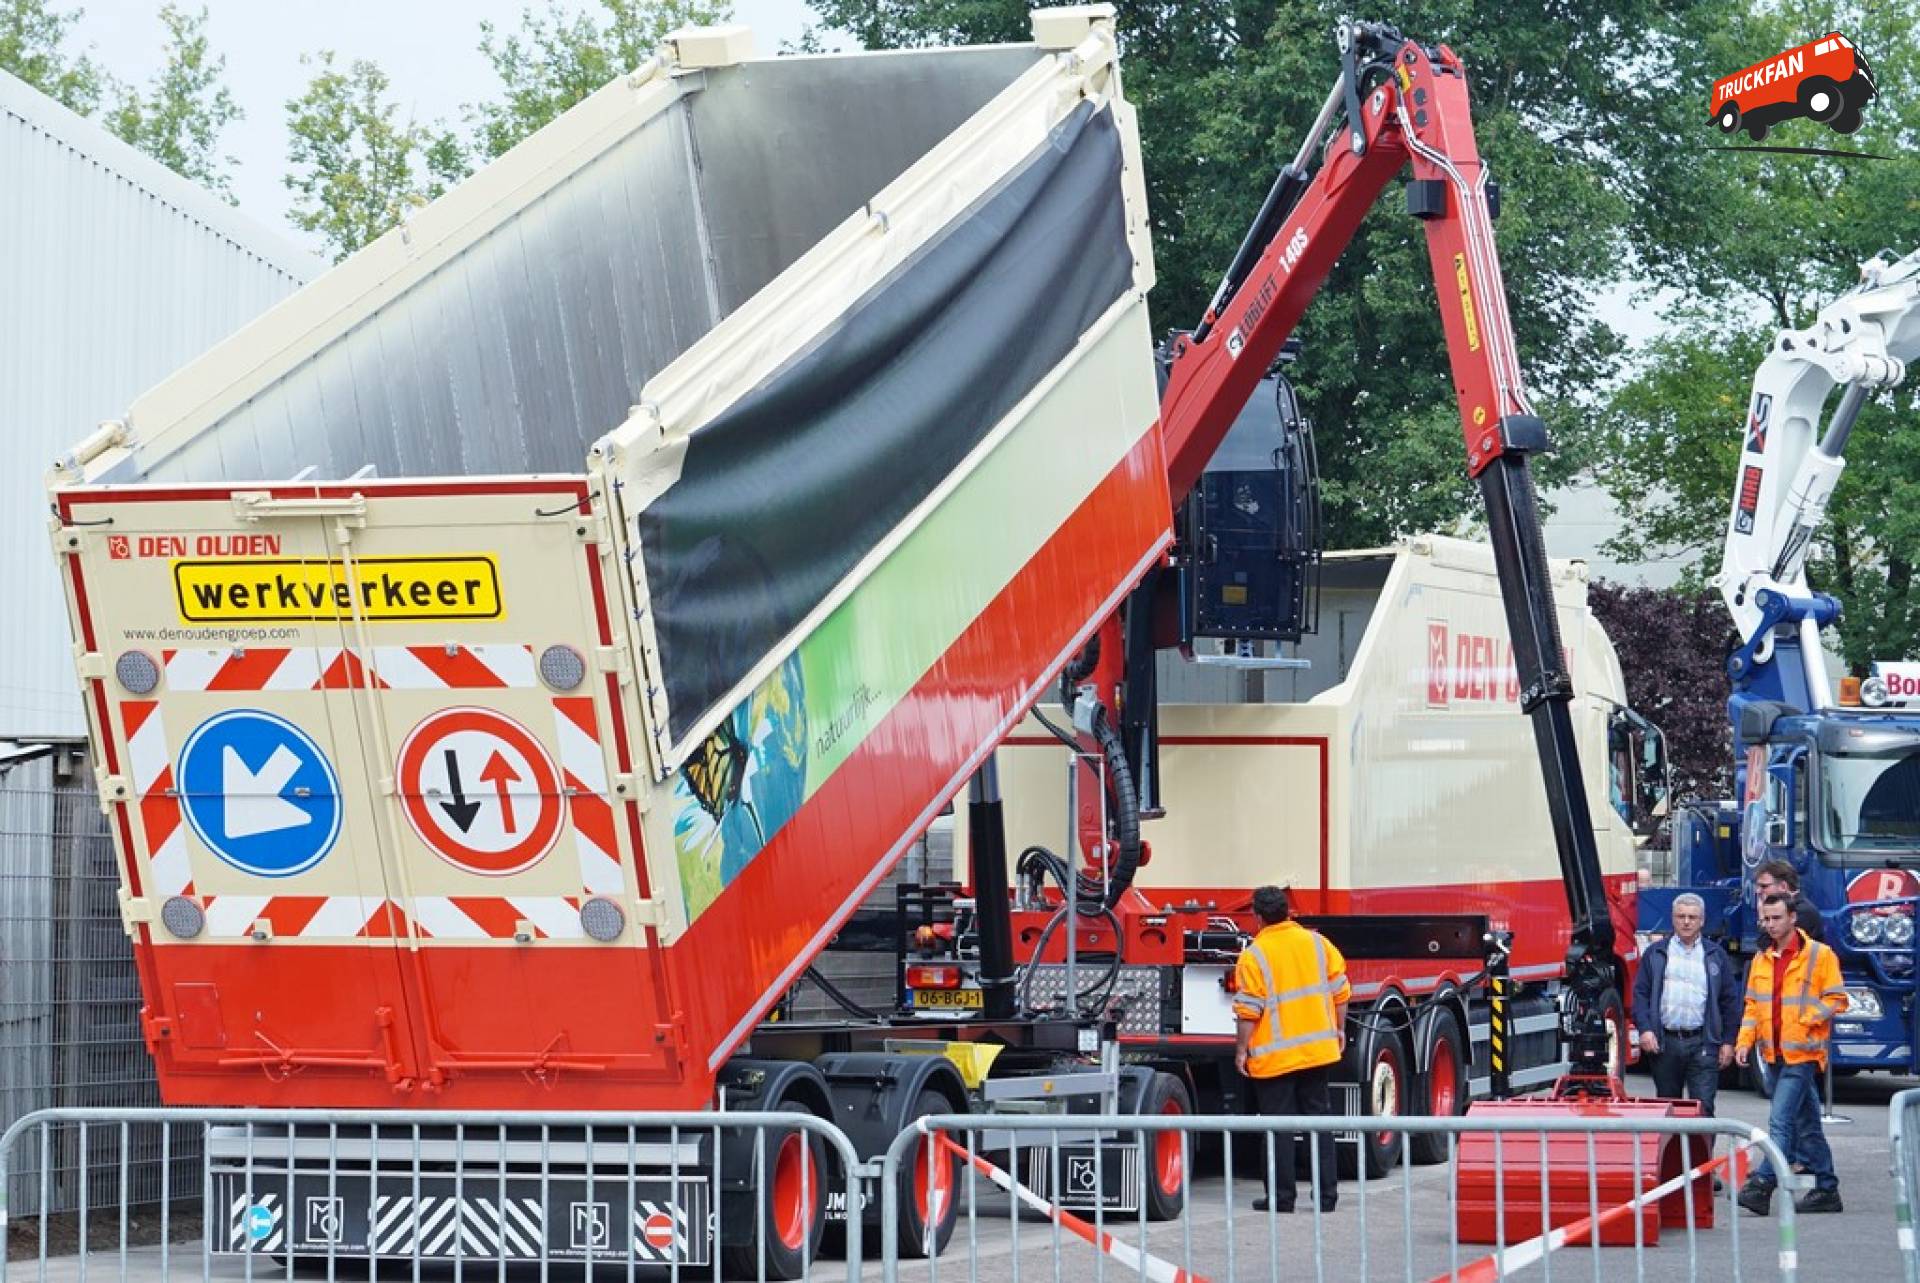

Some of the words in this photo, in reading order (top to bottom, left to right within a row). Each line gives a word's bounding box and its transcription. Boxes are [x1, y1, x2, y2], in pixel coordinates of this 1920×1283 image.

[1279, 226, 1309, 274] 140S
[138, 535, 187, 558] DEN
[196, 534, 281, 556] OUDEN
[193, 573, 481, 609] werkverkeer
[124, 627, 300, 641] www.denoudengroep.com
[1454, 633, 1499, 702] DEN
